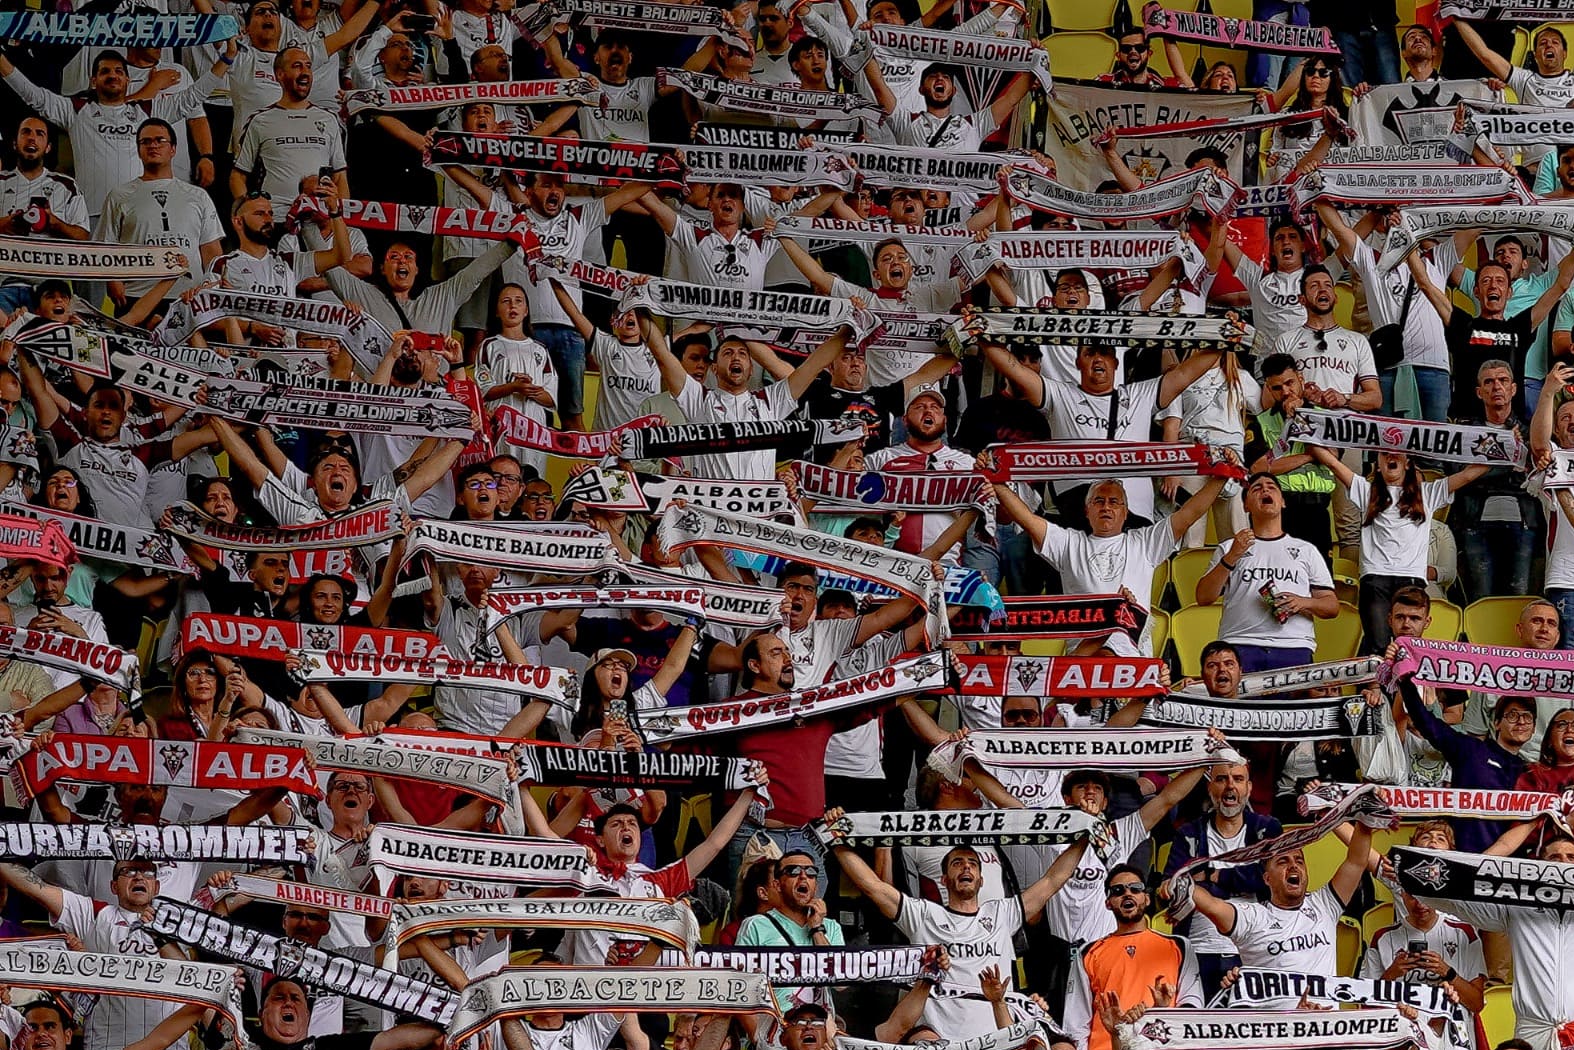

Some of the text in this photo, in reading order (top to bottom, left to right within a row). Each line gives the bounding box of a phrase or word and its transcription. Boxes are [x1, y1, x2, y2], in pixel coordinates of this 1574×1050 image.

[31, 11, 198, 40] ALBACETE
[389, 84, 472, 105] ALBACETE
[275, 136, 326, 146] SOLISS
[1002, 239, 1085, 258] ALBACETE
[1012, 315, 1132, 335] ALBACETE
[1324, 414, 1464, 456] AÚPA ALBA
[1013, 448, 1192, 467] LOCURA POR EL ALBA
[416, 525, 505, 554] ALBACETE
[714, 514, 880, 570] ALBACETE
[1411, 641, 1425, 649] MI
[1429, 641, 1466, 653] MAMÁ
[1469, 644, 1488, 654] ME
[1492, 648, 1520, 657] HIZO
[1524, 651, 1561, 661] GUAPA
[326, 650, 552, 688] QUIJOTE BLANCO
[686, 668, 895, 730] QUIJOTE BLANCO
[985, 738, 1088, 756] ALBACETE
[34, 739, 309, 782] AUPA ALBA
[545, 746, 628, 774] ALBACETE
[880, 812, 1005, 831] ALBACETE
[971, 836, 995, 844] ALBA
[153, 903, 455, 1025] CURVA ROMMEL
[501, 978, 693, 1005] ALBACETE
[1182, 1021, 1287, 1039] ALBACETE
